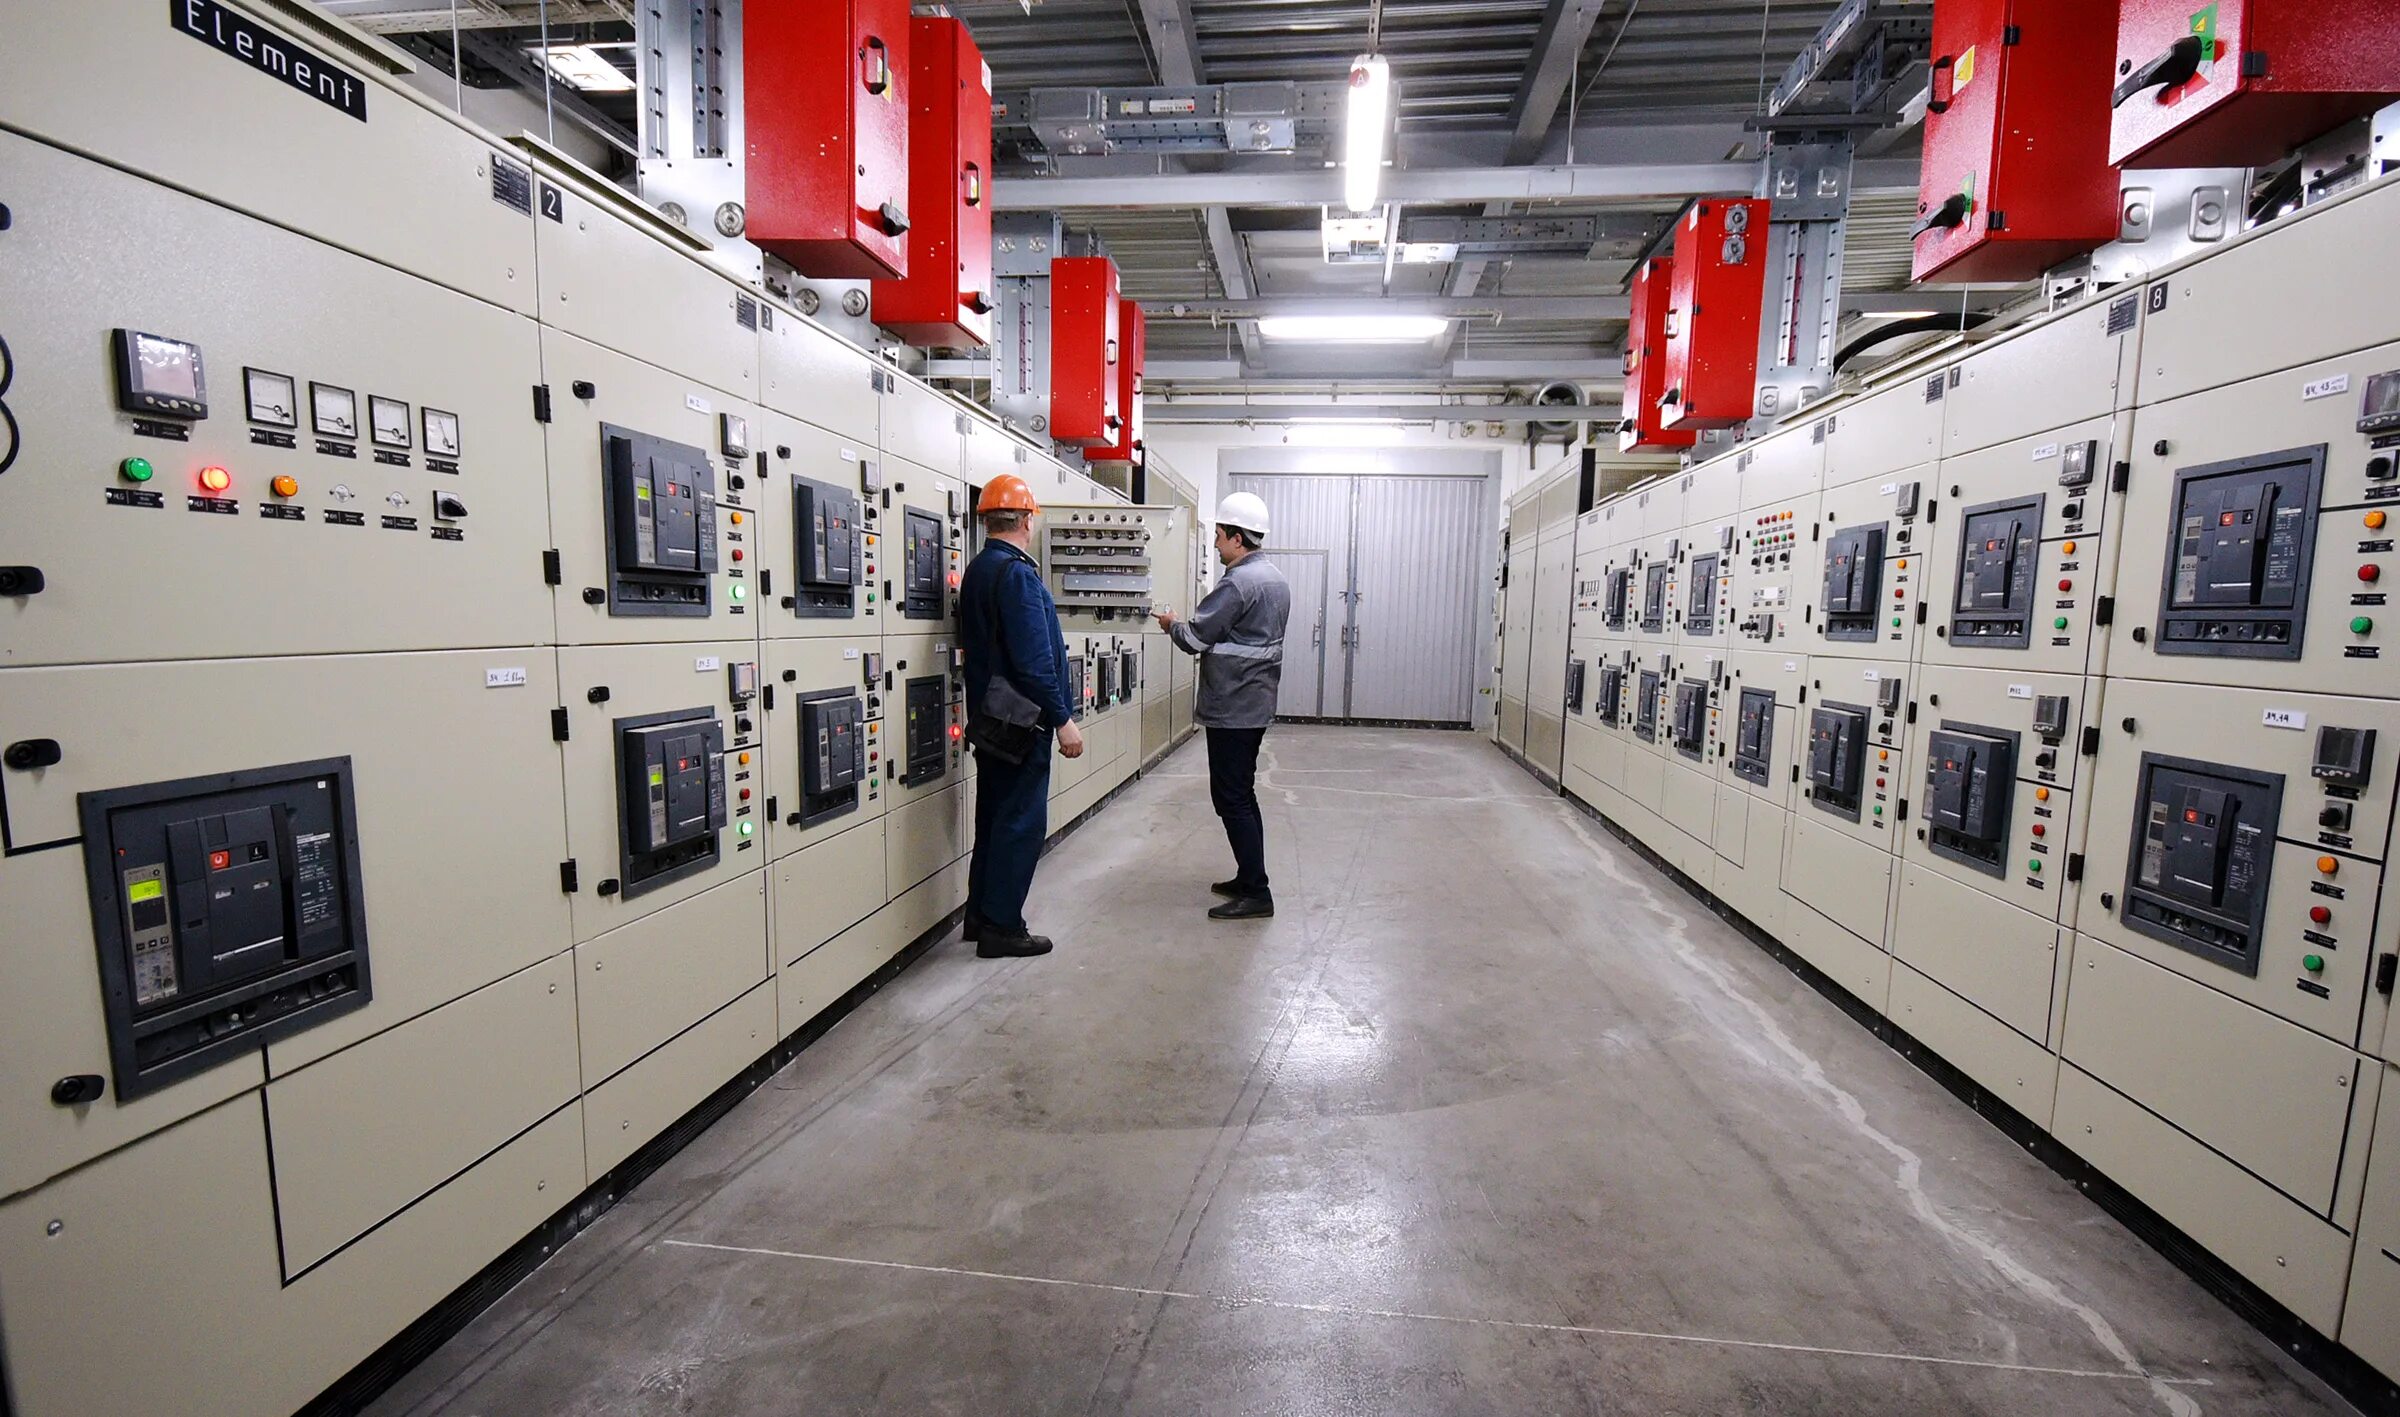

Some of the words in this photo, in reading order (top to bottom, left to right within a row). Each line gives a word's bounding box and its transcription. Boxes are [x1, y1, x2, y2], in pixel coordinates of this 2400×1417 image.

[187, 0, 353, 107] Element
[547, 190, 557, 216] 2
[2153, 287, 2162, 308] 8
[764, 307, 770, 326] 3
[1952, 369, 1959, 386] 7
